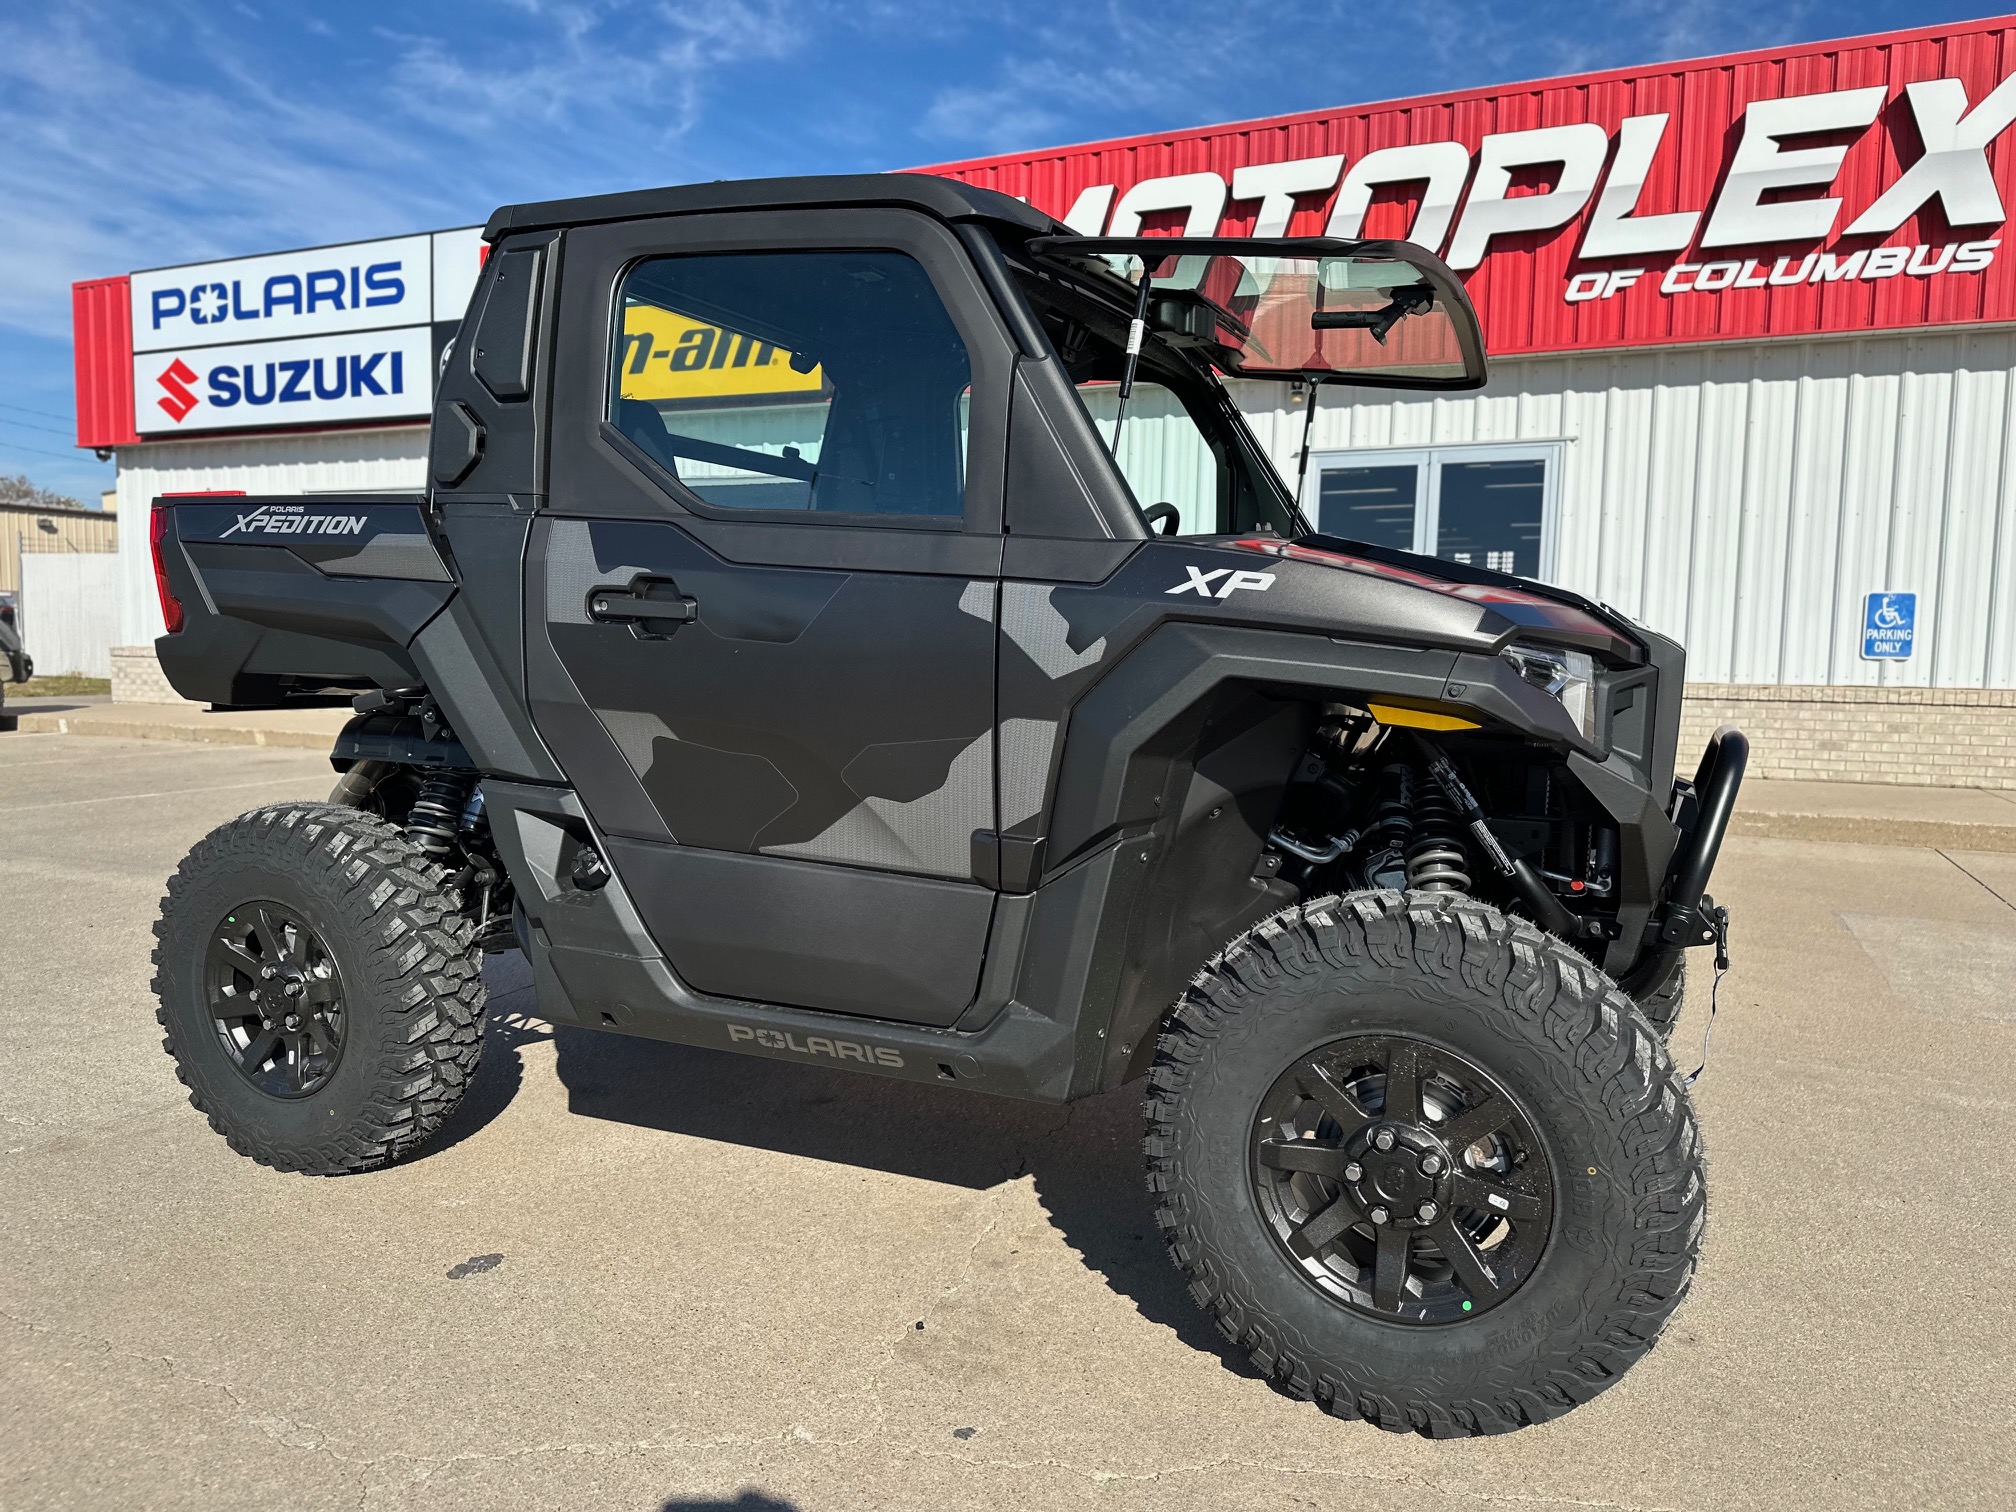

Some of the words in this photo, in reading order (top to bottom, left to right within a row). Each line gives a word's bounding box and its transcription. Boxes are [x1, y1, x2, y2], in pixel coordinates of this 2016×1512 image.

[1565, 267, 1645, 301] OF
[1660, 239, 2002, 295] COLUMBUS
[151, 261, 406, 330] POLARIS
[207, 350, 404, 408] SUZUKI
[218, 506, 368, 538] XPEDITION
[269, 505, 305, 513] POLARIS
[1164, 565, 1277, 598] XP
[1866, 628, 1912, 640] PARKING
[1873, 641, 1902, 653] ONLY
[726, 1023, 905, 1068] POLARIS
